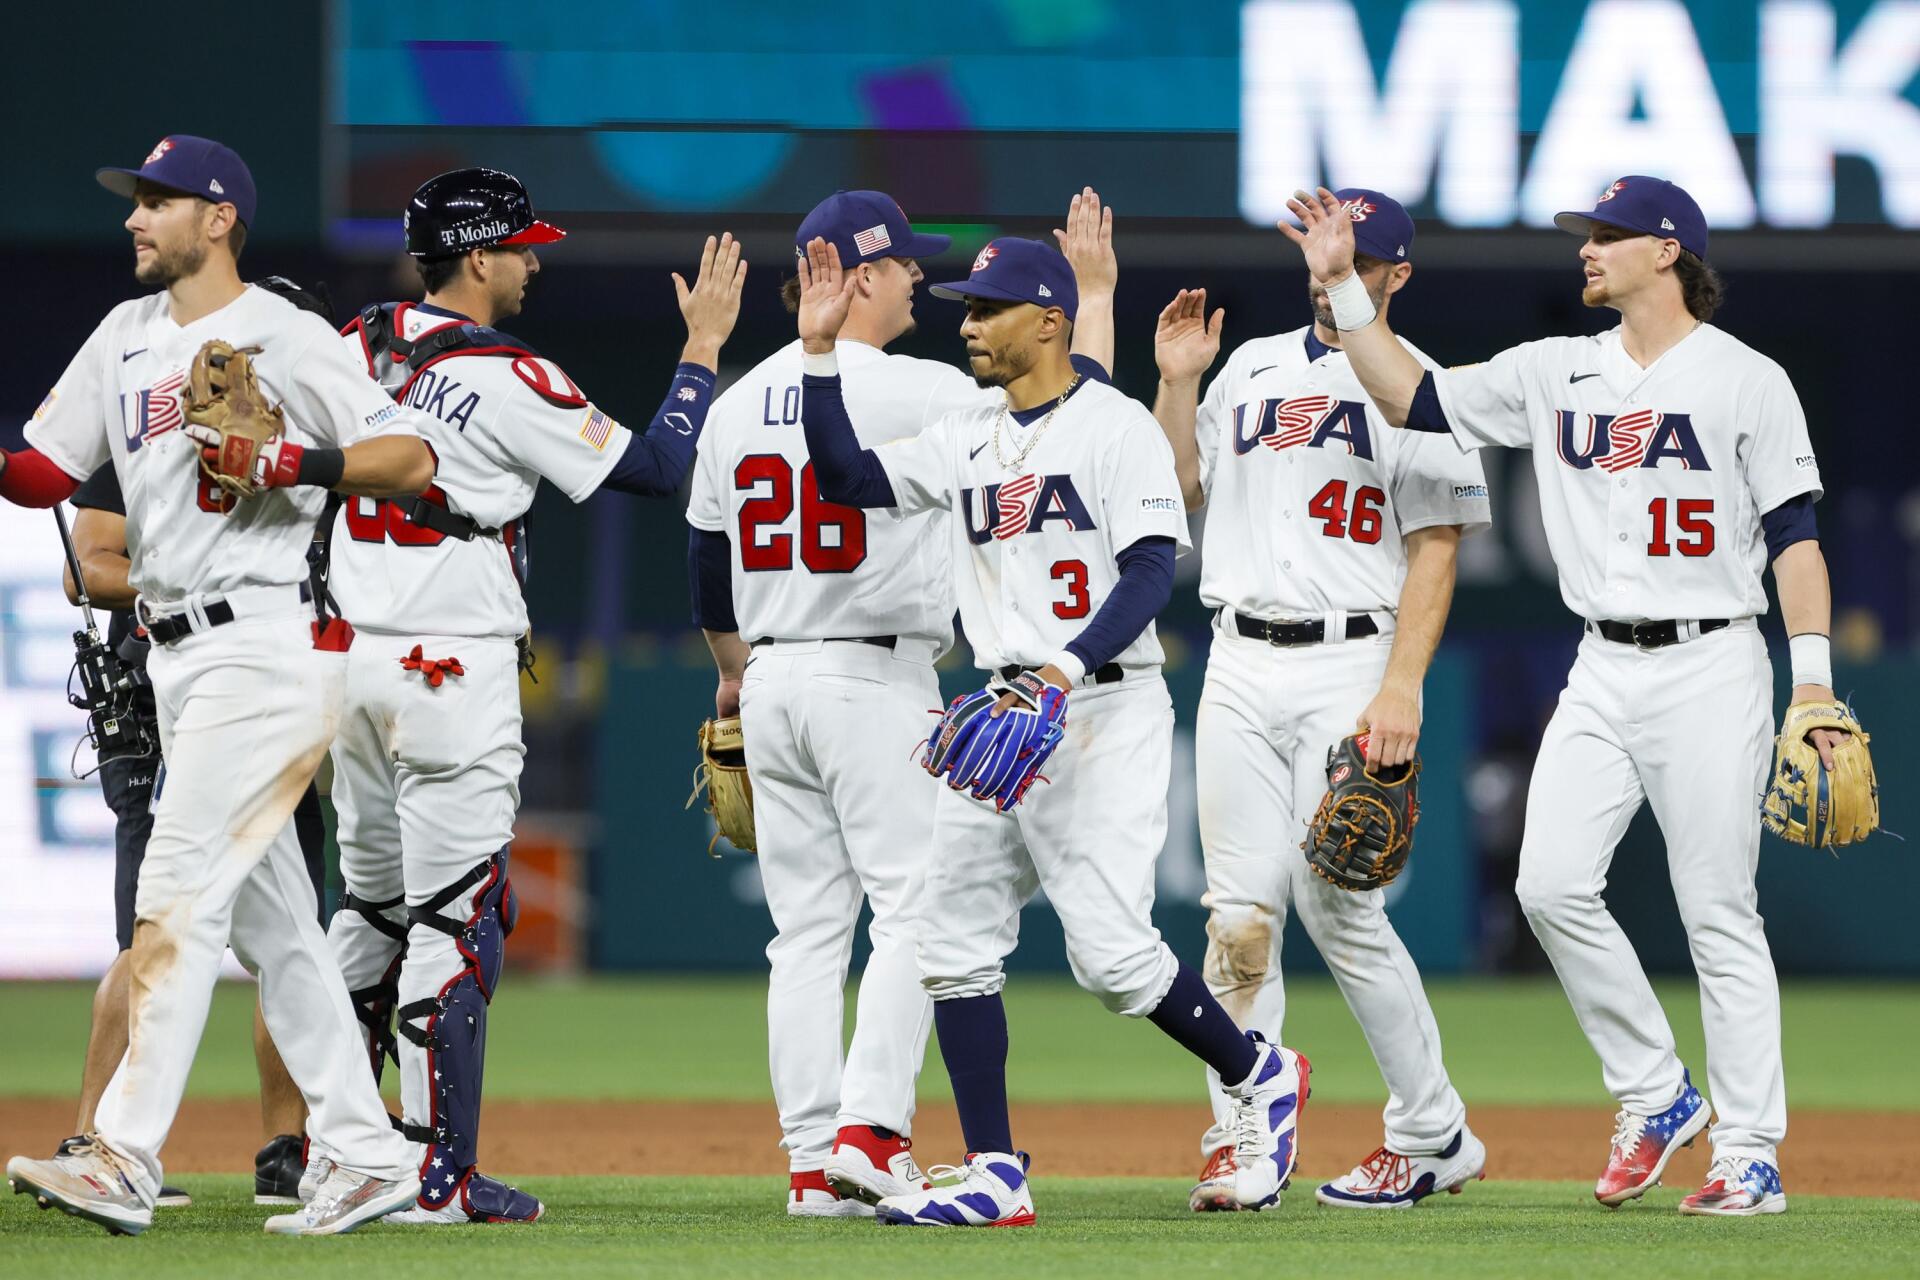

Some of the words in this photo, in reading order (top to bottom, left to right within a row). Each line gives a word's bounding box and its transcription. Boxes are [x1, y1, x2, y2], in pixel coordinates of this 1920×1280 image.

[459, 220, 510, 243] Mobile
[1232, 395, 1374, 462] USA
[1555, 408, 1713, 474] USA
[734, 453, 868, 574] 26
[960, 473, 1098, 546] USA
[1308, 478, 1386, 545] 46
[1647, 497, 1715, 557] 15
[1050, 559, 1091, 620] 3
